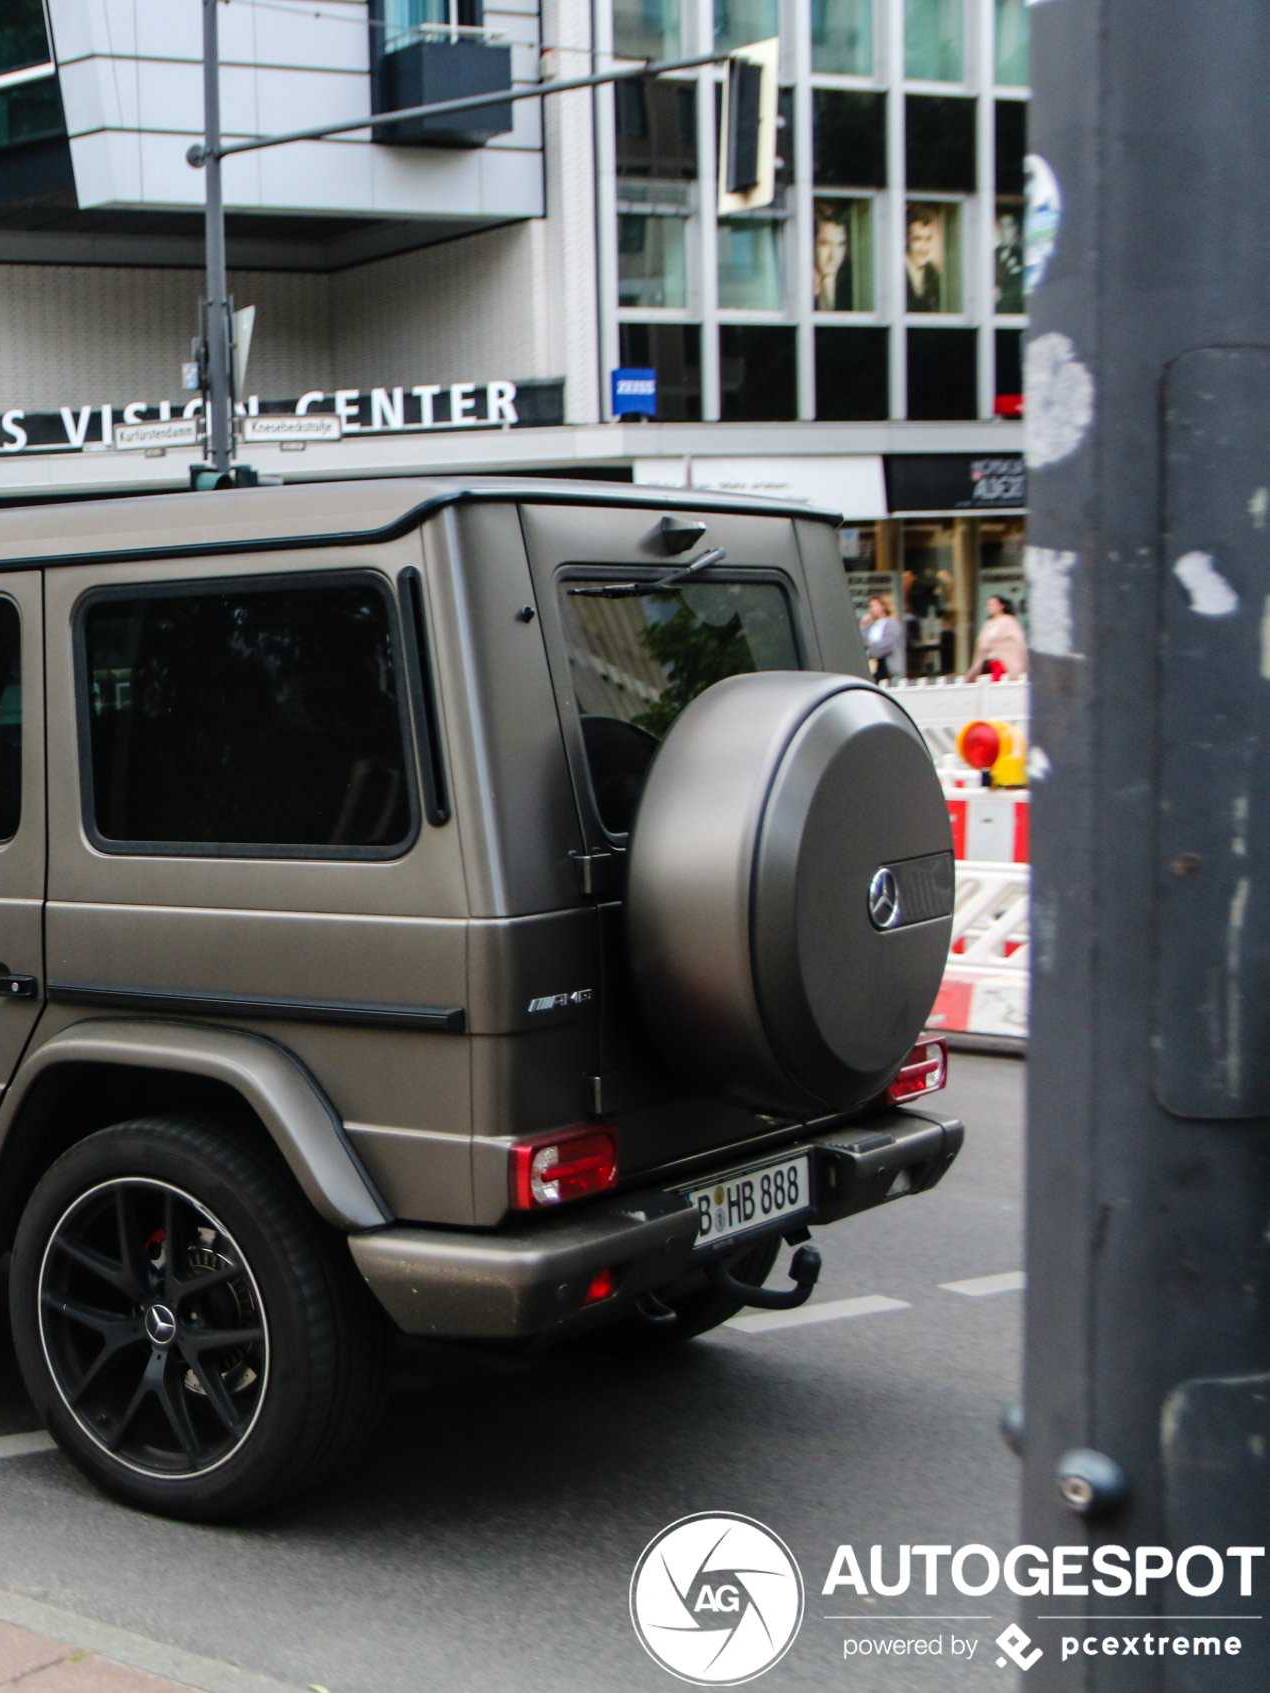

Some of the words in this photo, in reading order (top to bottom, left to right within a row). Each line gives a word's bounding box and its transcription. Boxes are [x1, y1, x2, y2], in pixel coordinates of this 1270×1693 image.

[617, 380, 656, 395] ZEISS
[294, 379, 519, 434] CENTER
[119, 425, 193, 443] Kurfürstendamm
[698, 1199, 713, 1238] B
[727, 1181, 756, 1229] HB
[760, 1165, 800, 1215] 888
